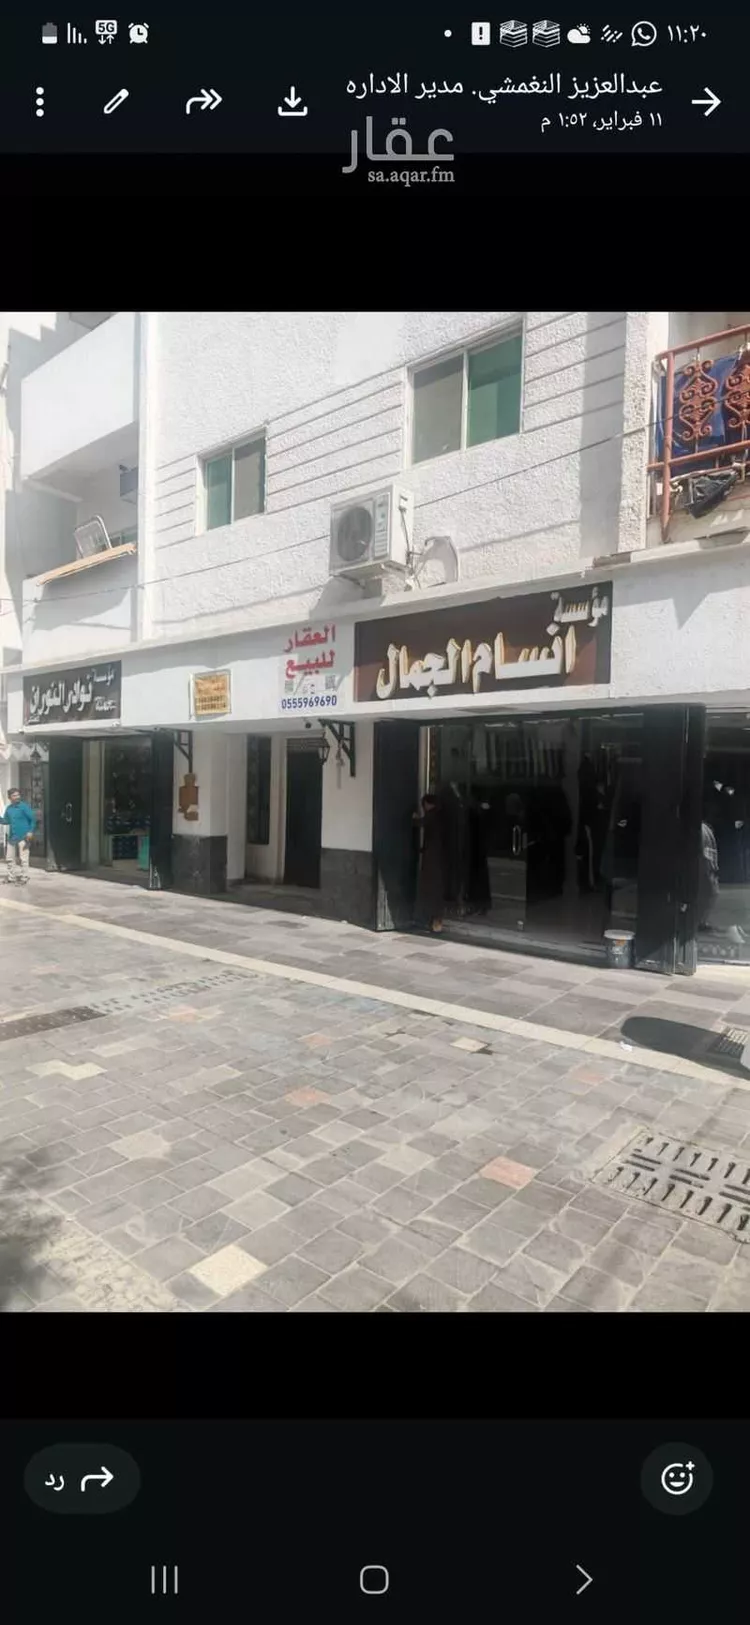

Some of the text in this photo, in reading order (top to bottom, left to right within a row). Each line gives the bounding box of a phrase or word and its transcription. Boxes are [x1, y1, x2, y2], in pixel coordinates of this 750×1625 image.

[551, 587, 608, 627] مؤسسة
[284, 623, 336, 653] العقار
[285, 649, 336, 679] للبيع
[376, 637, 472, 699] الجمال
[281, 694, 338, 710] 0555969690
